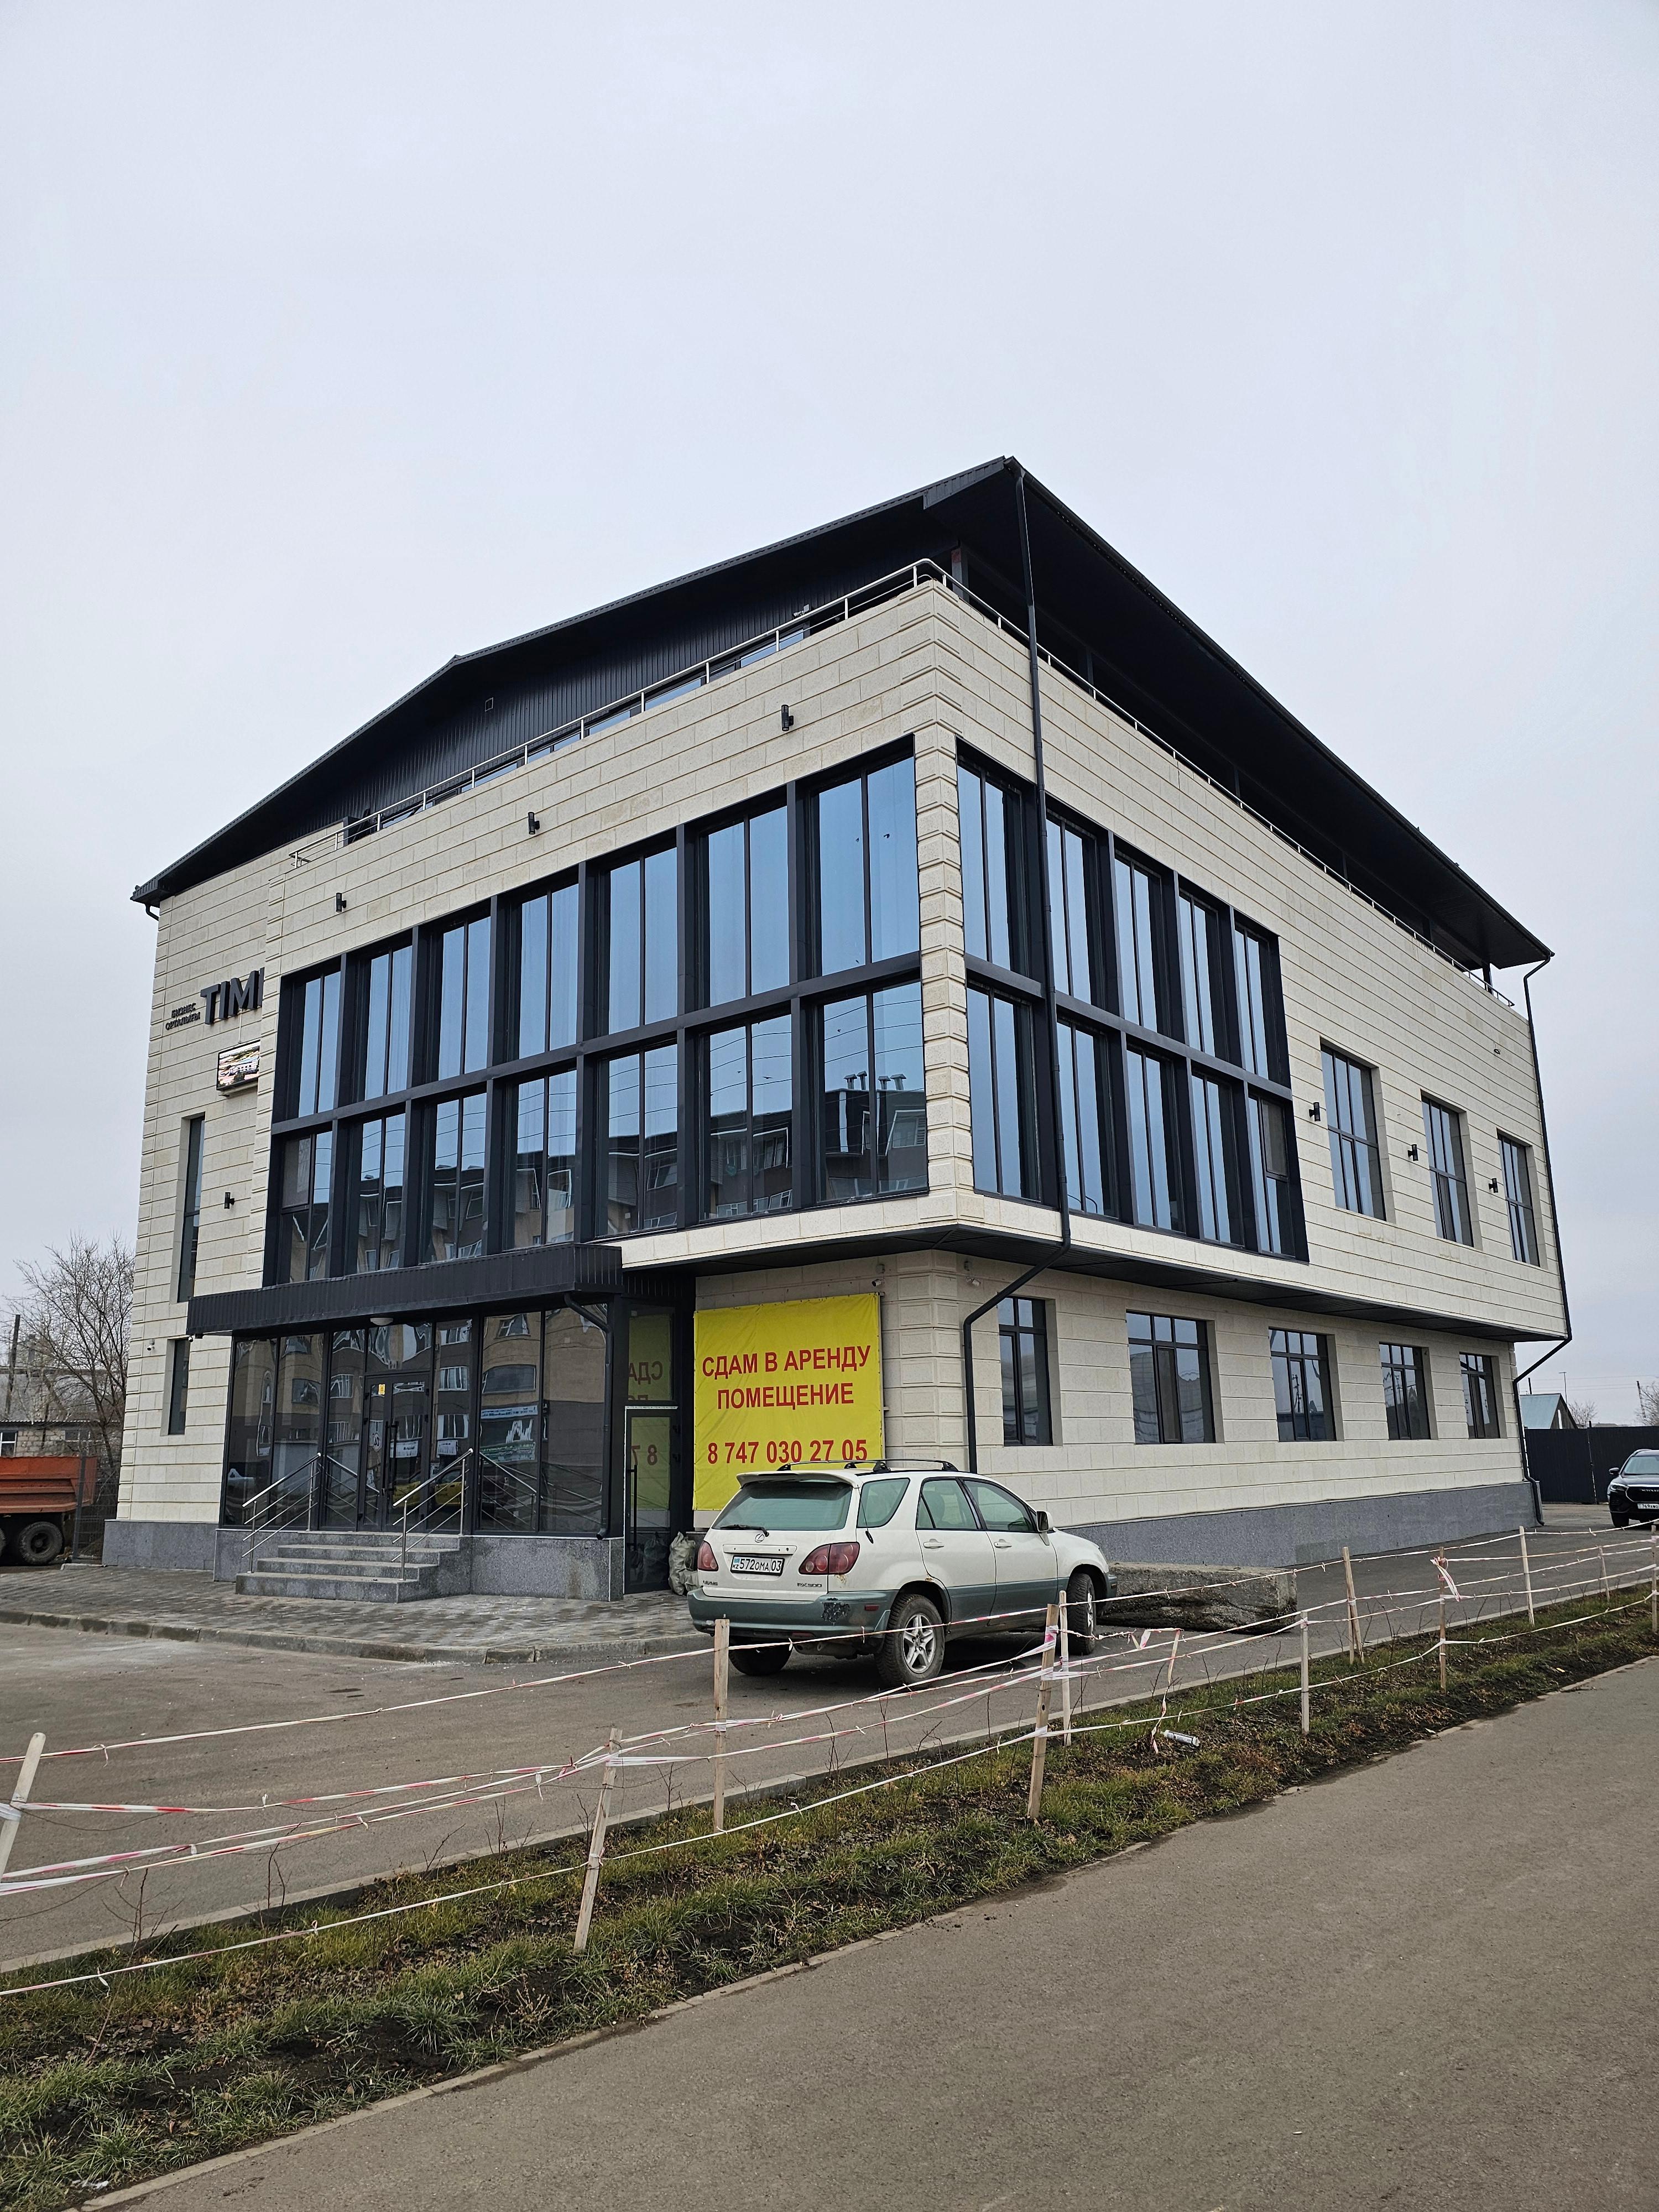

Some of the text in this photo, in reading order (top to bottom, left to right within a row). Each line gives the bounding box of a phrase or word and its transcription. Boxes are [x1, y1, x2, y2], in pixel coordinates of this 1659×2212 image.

[171, 1003, 196, 1018] БИЗНЕС
[702, 1345, 871, 1379] СДАМ В АРЕНДУ
[717, 1382, 854, 1410] ПОМЕЩЕНИЕ
[707, 1439, 868, 1464] 8 747 030 27 05
